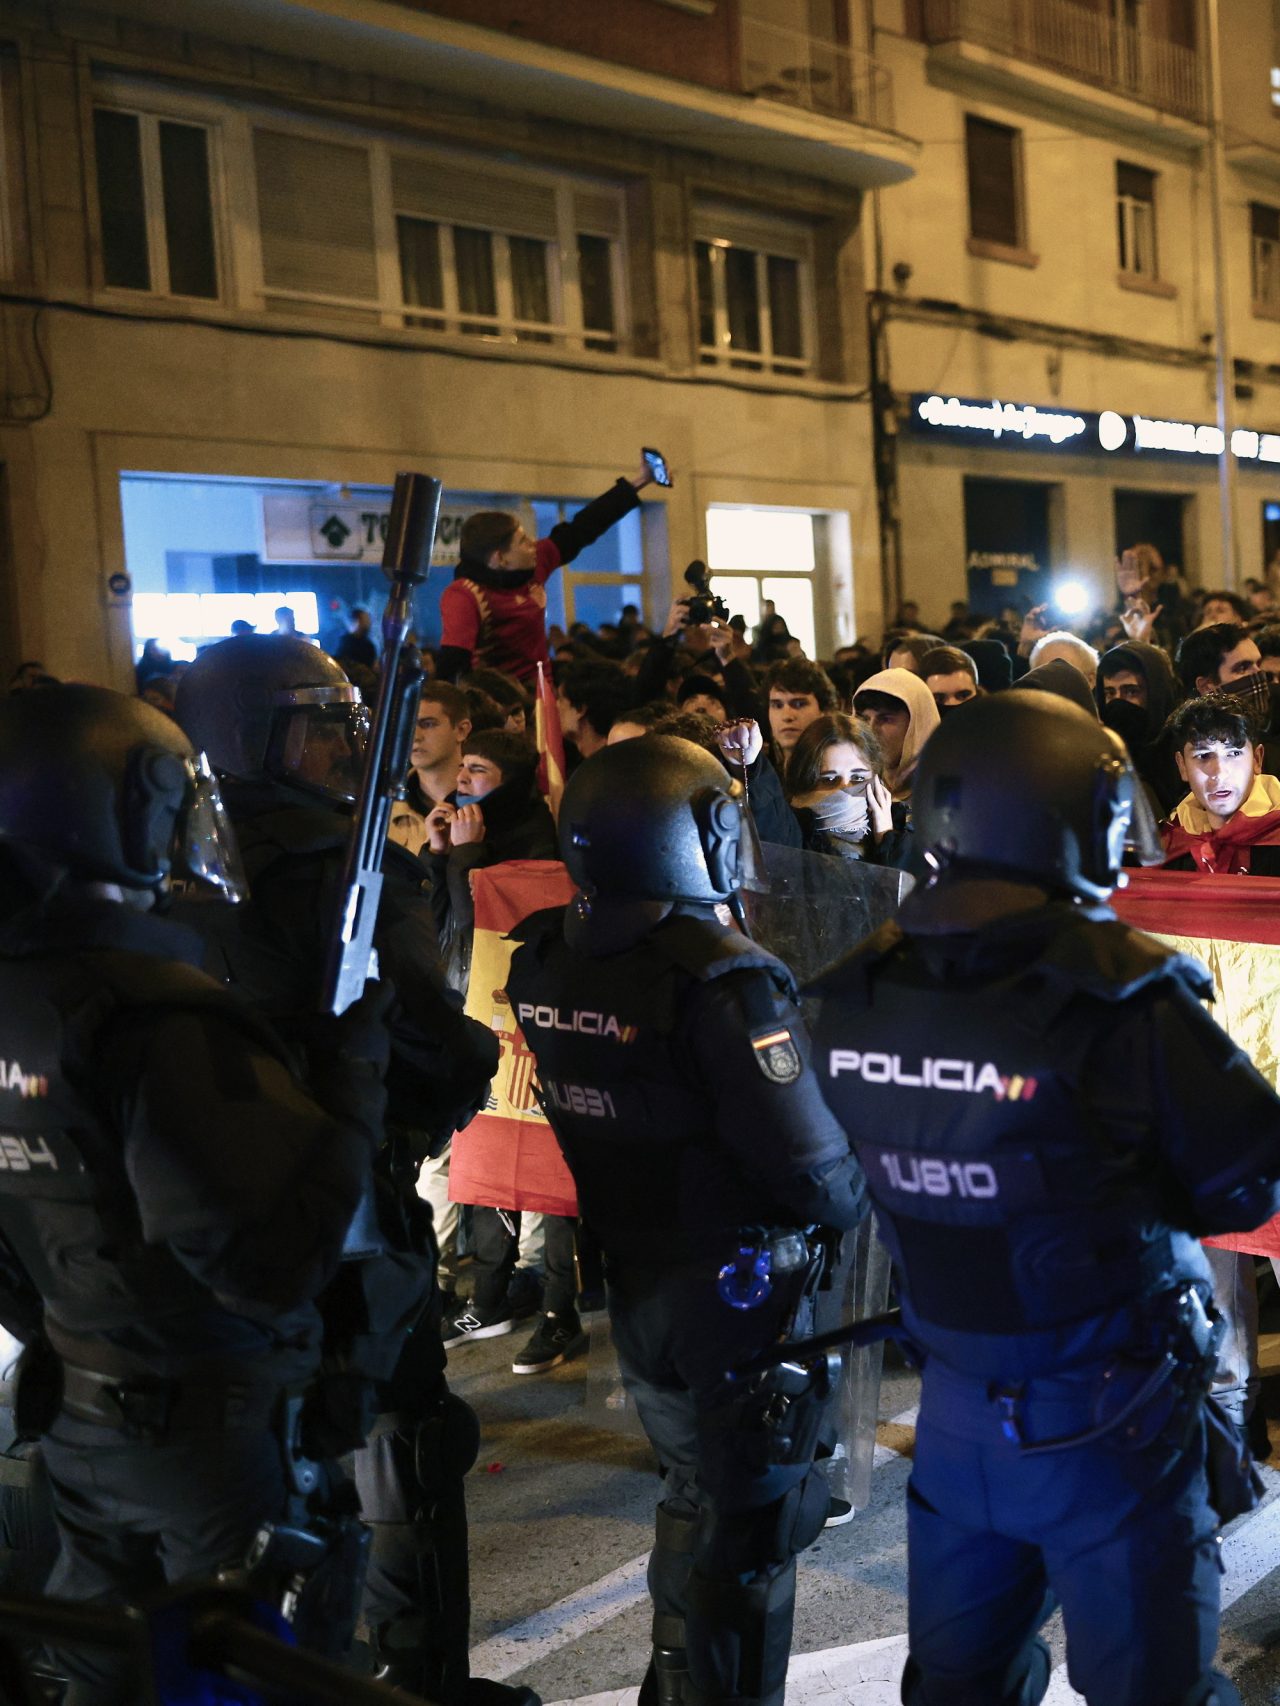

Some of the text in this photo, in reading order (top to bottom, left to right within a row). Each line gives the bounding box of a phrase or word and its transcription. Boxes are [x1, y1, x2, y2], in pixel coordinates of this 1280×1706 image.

[518, 1002, 621, 1038] POLICIA
[829, 1049, 1006, 1095] POLICIA
[880, 1153, 998, 1198] 1U810
